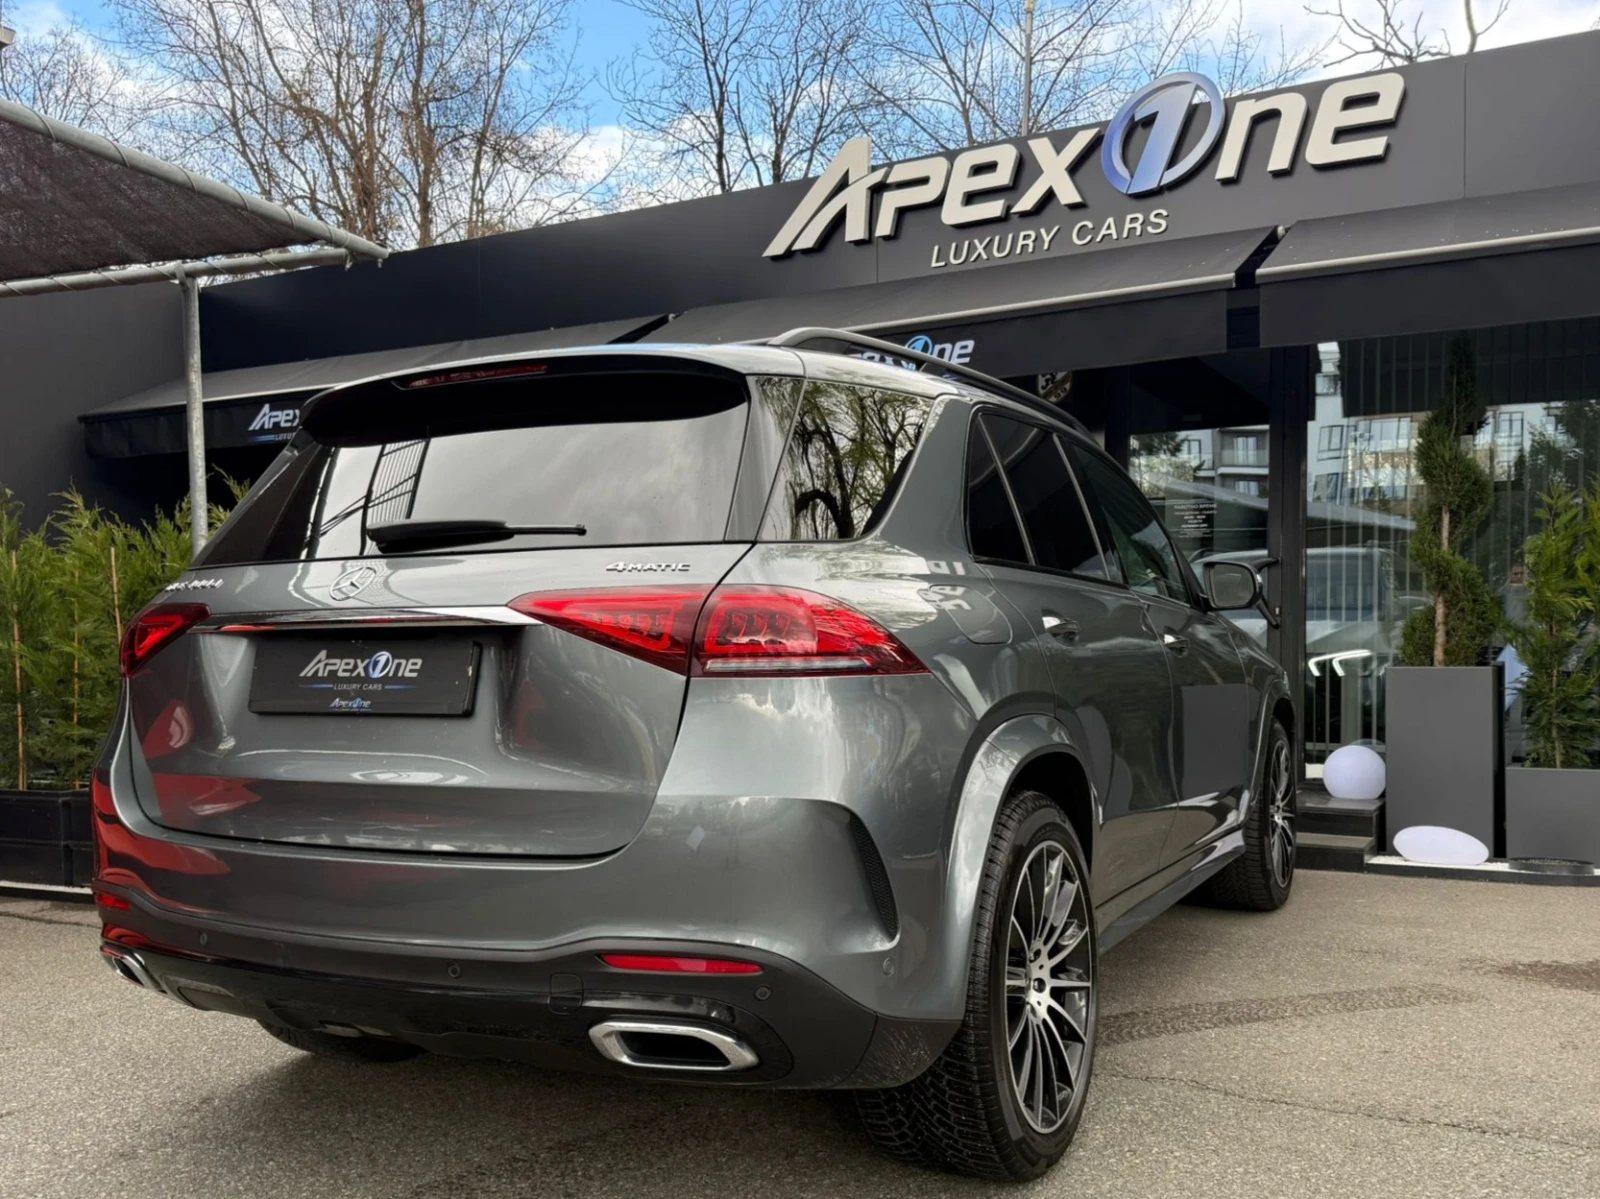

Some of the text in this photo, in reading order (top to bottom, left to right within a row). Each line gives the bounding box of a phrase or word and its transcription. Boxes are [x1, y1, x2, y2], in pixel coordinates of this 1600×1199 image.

[930, 208, 1169, 268] LUXURY CARS
[605, 561, 691, 573] 4MATIC
[333, 683, 382, 691] LUXURY CARS
